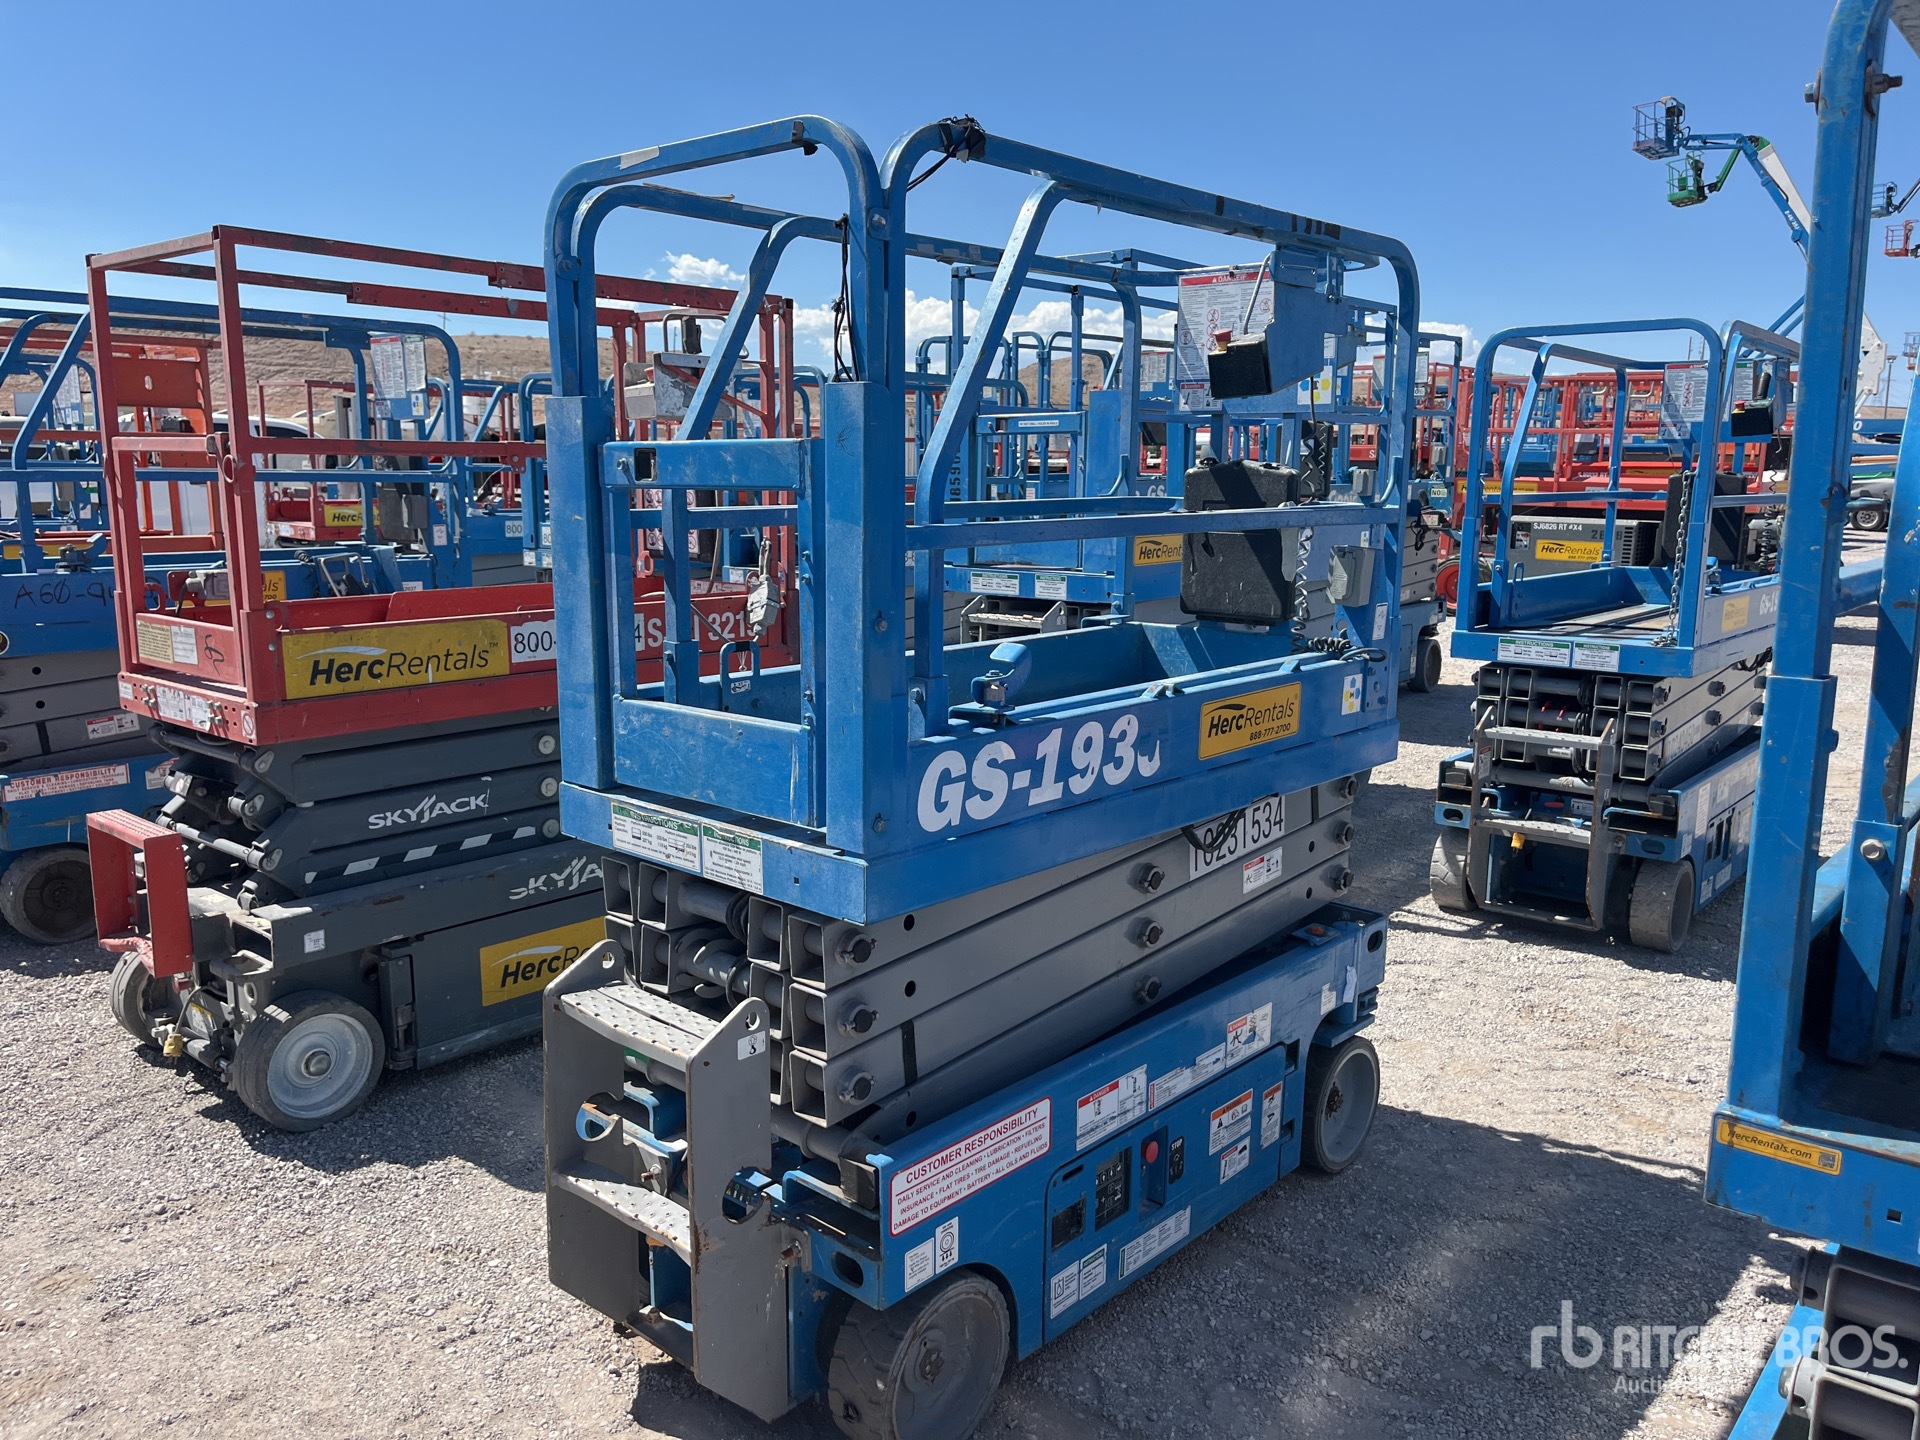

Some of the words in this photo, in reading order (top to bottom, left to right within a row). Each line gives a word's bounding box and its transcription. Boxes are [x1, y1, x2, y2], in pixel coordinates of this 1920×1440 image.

[1541, 545, 1600, 556] HercRentals
[309, 644, 489, 686] HercRentals
[1207, 698, 1295, 738] HercRentals
[1249, 722, 1291, 741] 888-777-2700
[368, 793, 489, 830] SKYJACK
[1093, 1087, 1109, 1100] DANGER
[906, 1148, 962, 1184] CUSTOMER
[964, 1108, 1038, 1154] RESPONSIBILITY
[1171, 1138, 1183, 1151] STOP
[1728, 1130, 1812, 1159] HercRentals.com
[898, 1192, 914, 1205] DAILY
[916, 1179, 940, 1196] SERVICE
[941, 1172, 954, 1181] AND
[955, 1156, 983, 1175] CLEANING
[987, 1134, 1021, 1157] LUBRICATION
[1025, 1123, 1045, 1137] FILTERS
[900, 1190, 934, 1215] INSURANCE
[939, 1182, 952, 1194] FLAT
[954, 1173, 970, 1185] TIRES
[975, 1164, 986, 1174] TIRE
[988, 1151, 1010, 1169] DAMAGE
[1014, 1134, 1042, 1154] REFUELING
[894, 1212, 919, 1230] DAMAGE
[921, 1206, 929, 1215] TO
[930, 1189, 962, 1210] EQUIPMENT
[967, 1172, 992, 1190] BATTERY
[995, 1166, 1005, 1175] ALL
[1006, 1158, 1017, 1169] OILS
[1018, 1152, 1029, 1162] AND
[1031, 1142, 1047, 1157] FLUIDS
